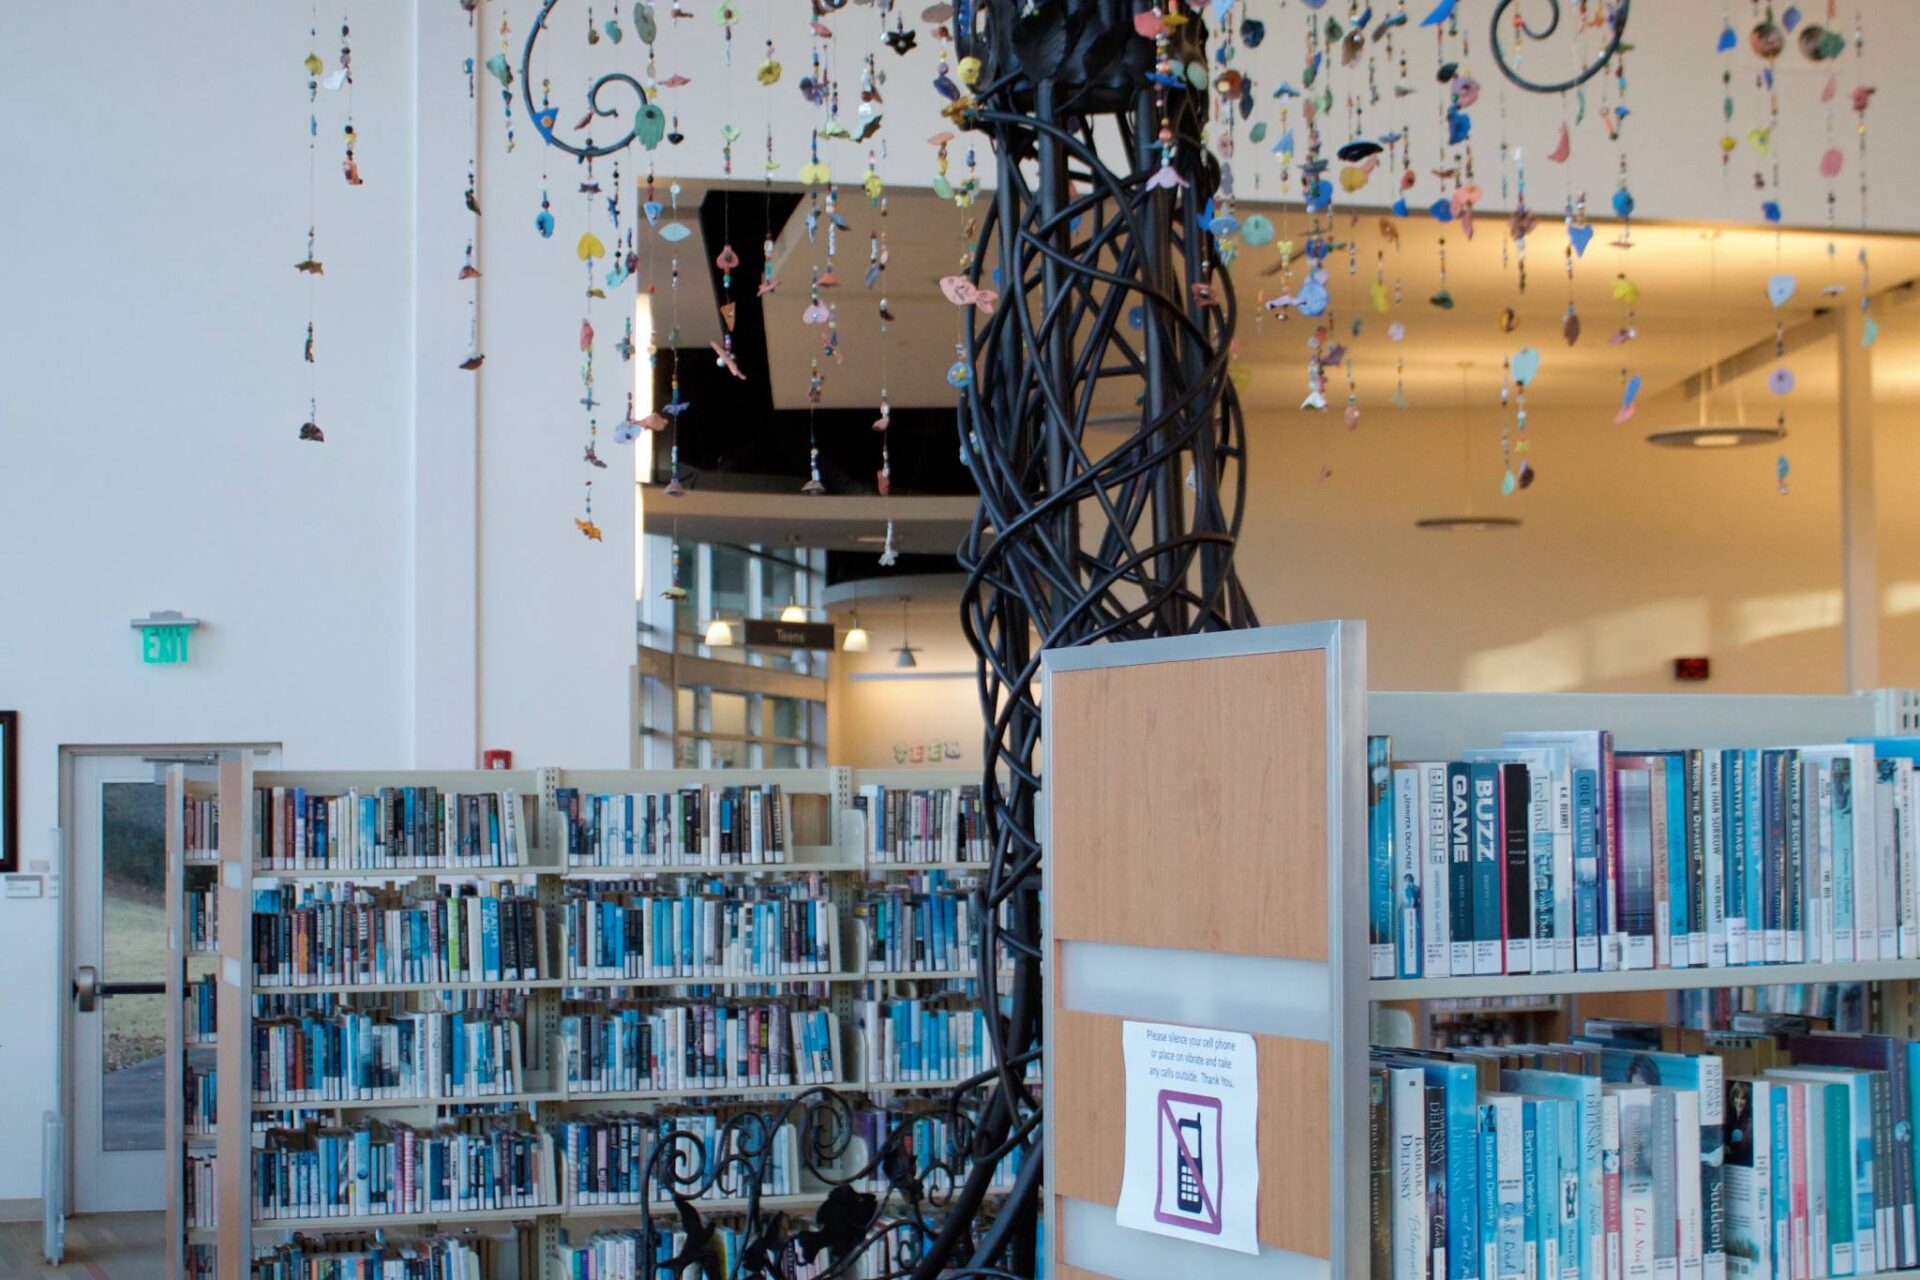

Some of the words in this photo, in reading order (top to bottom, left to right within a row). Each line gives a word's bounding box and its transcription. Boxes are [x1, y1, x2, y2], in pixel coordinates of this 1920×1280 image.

[143, 626, 192, 663] EXIT
[776, 628, 806, 643] Teens
[1733, 760, 1744, 818] NEGATIVE
[1791, 760, 1800, 805] WINTER
[1452, 775, 1468, 863] GAME
[1475, 778, 1494, 862] BUZZ
[1579, 808, 1593, 854] KILLING
[1712, 816, 1722, 855] SORROW
[1734, 821, 1745, 858] IMAGE
[1791, 819, 1801, 866] SECRETS
[1146, 1029, 1168, 1043] Please
[1168, 1032, 1188, 1045] silence
[1189, 1036, 1202, 1047] your
[1203, 1036, 1214, 1048] cell
[1215, 1039, 1236, 1051] phone
[1150, 1050, 1157, 1058] or
[1158, 1050, 1175, 1062] place
[1176, 1053, 1184, 1062] on
[1185, 1052, 1205, 1066] vibrate
[1205, 1056, 1217, 1067] and
[1218, 1057, 1232, 1069] take
[1149, 1067, 1159, 1078] any
[1160, 1066, 1174, 1079] calls
[1175, 1069, 1198, 1082] outside.
[1201, 1072, 1220, 1086] Thank
[1430, 1102, 1441, 1166] DELINSKY
[1585, 1093, 1597, 1162] DELINSKY
[1775, 1103, 1785, 1149] Barbara
[1400, 1135, 1413, 1200] DELINSKY
[1485, 1135, 1496, 1179] Barbara
[1524, 1129, 1534, 1172] Barbara
[1484, 1181, 1496, 1228] Delinsky
[1523, 1173, 1536, 1217] Delinsky
